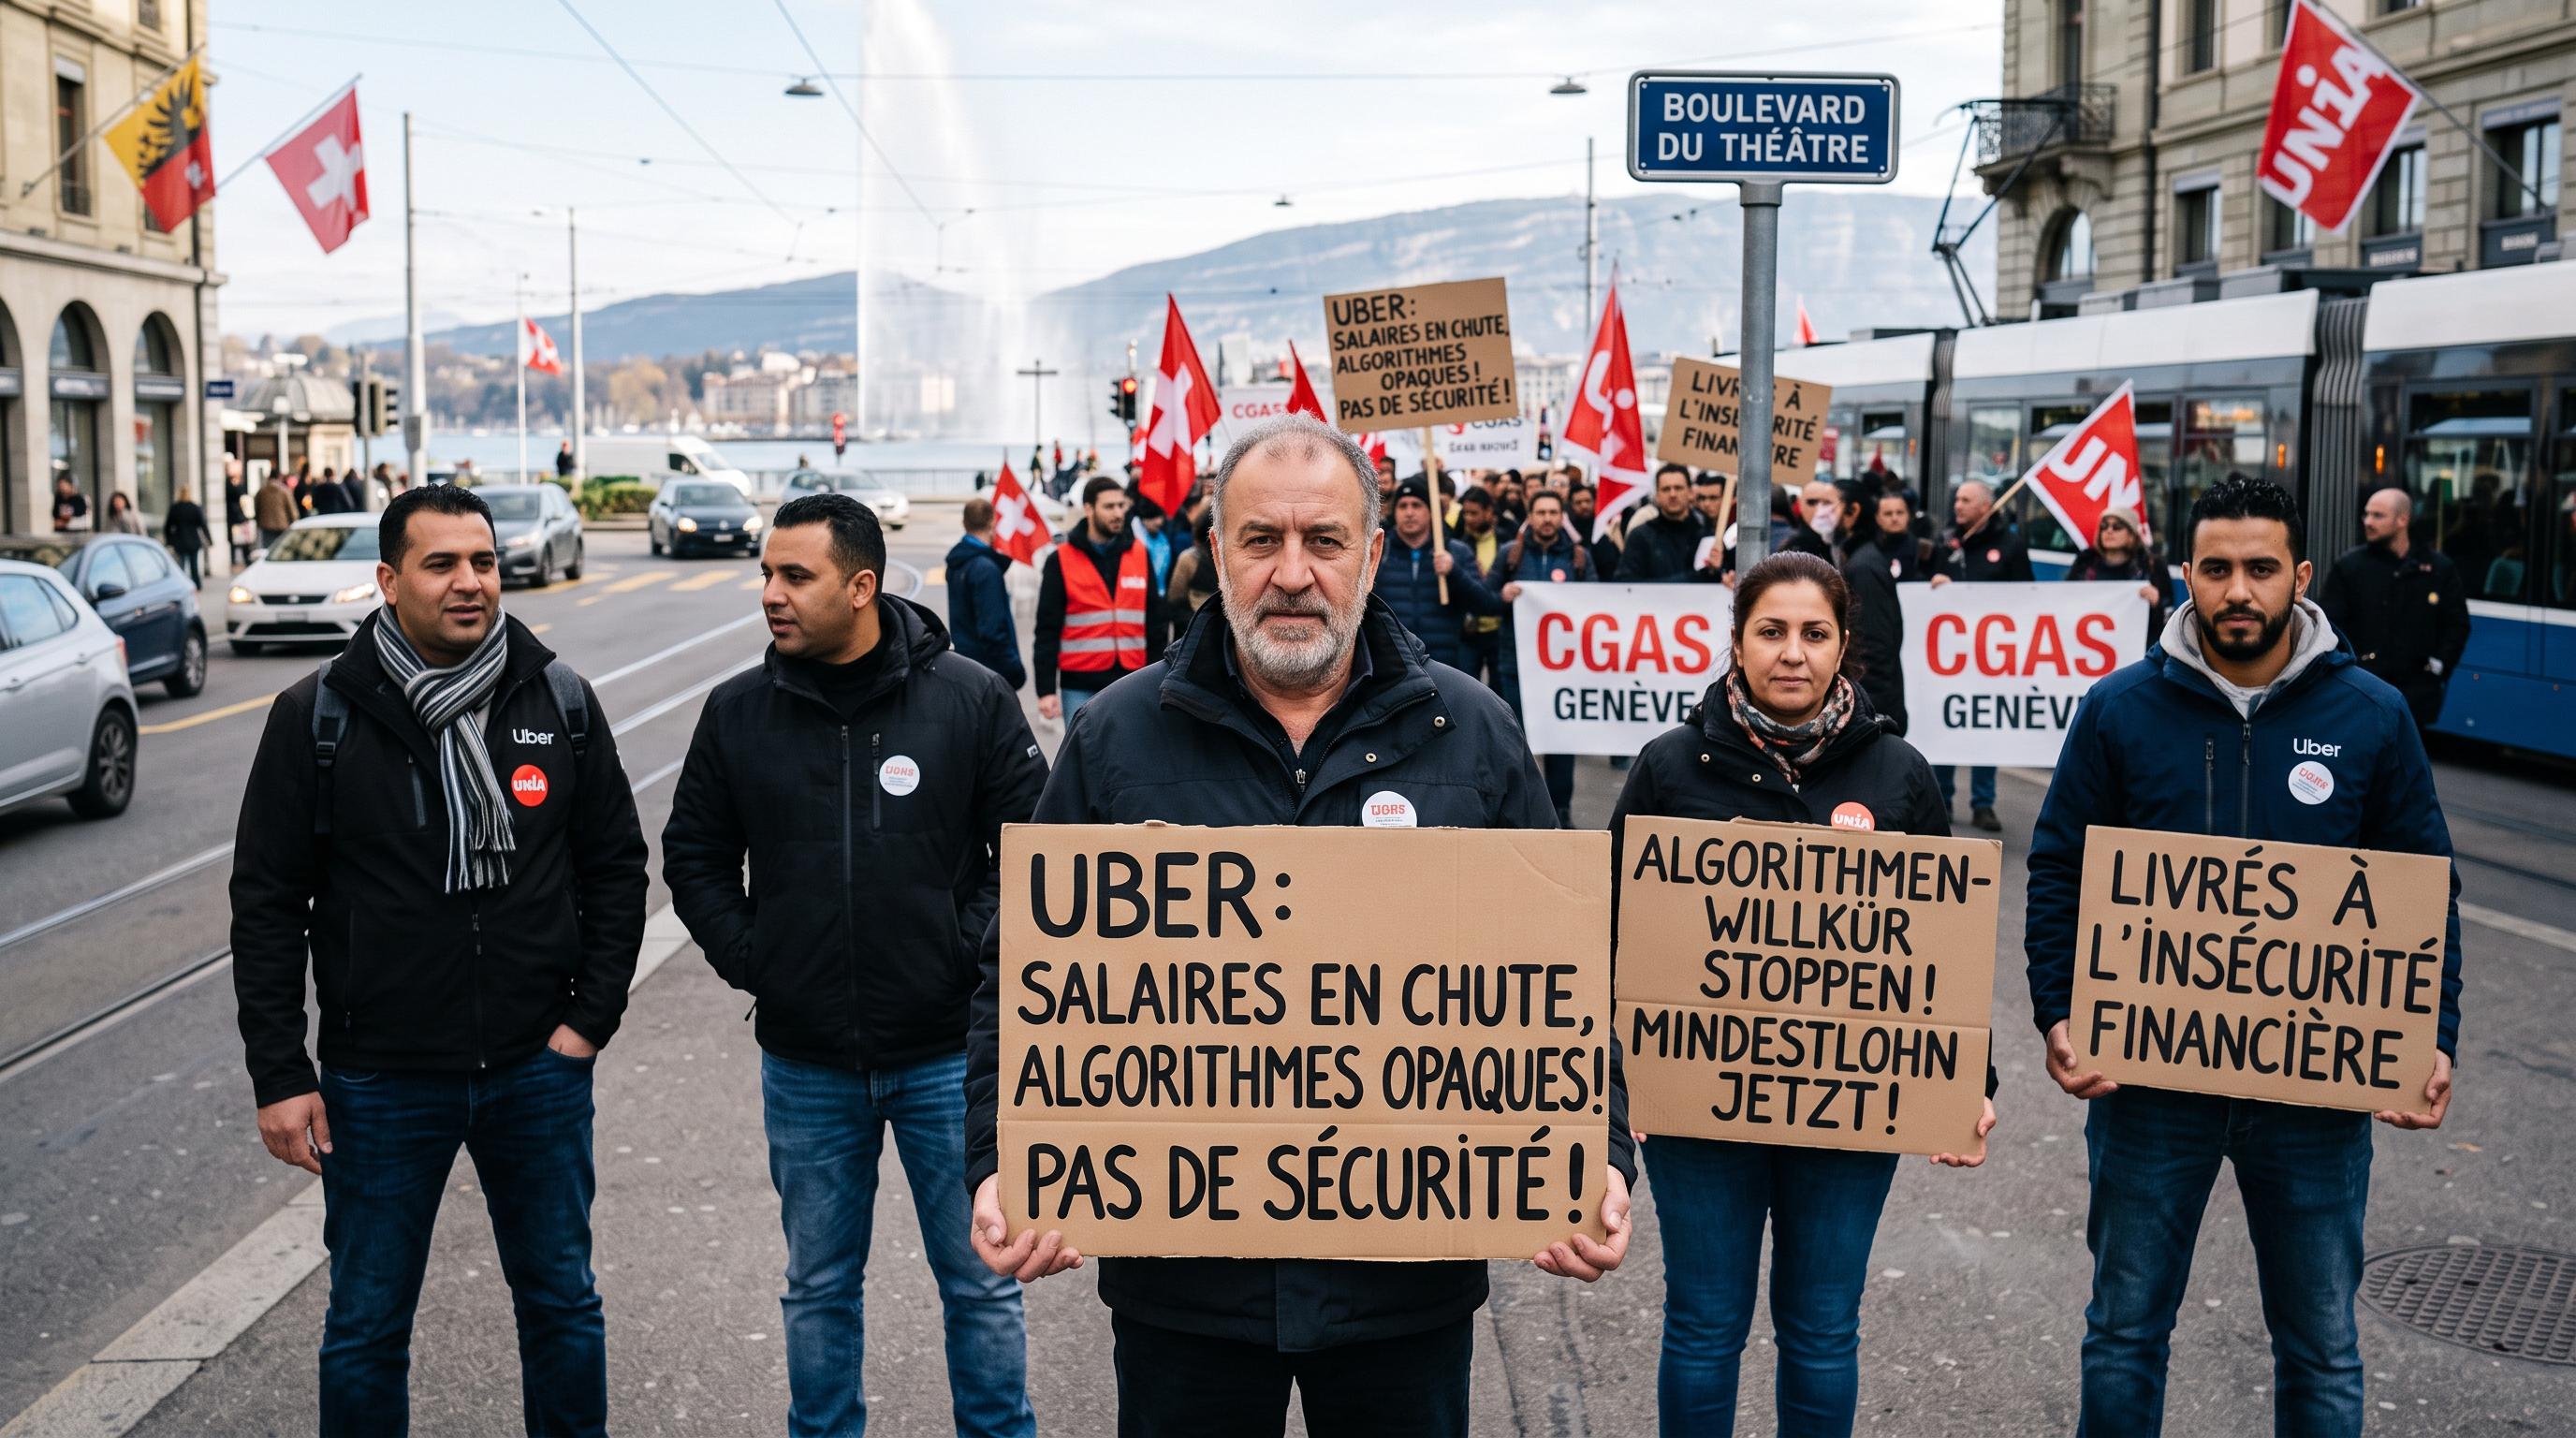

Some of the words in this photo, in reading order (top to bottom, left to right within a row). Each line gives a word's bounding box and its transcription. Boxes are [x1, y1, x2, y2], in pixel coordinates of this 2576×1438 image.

[1663, 93, 1866, 124] BOULEVARD
[1658, 132, 1703, 161] DU
[1720, 126, 1869, 163] THÉÂTRE
[1334, 323, 1420, 351] SALAIRES
[1425, 320, 1447, 342] EN
[1451, 314, 1510, 339] CHUTE,
[1337, 342, 1467, 374] ALGORITHMES
[1339, 397, 1374, 420] PAS
[1380, 394, 1403, 417] DE
[1785, 383, 1801, 411] À
[1537, 612, 1711, 674] CGAS
[1925, 613, 2117, 677] CGAS
[1942, 686, 2085, 730] GENÈV
[513, 728, 554, 745] Uber
[2293, 738, 2341, 757] Uber
[2111, 844, 2299, 920] LIVRÉS
[2332, 854, 2378, 930] À
[1705, 895, 1912, 957] WILLKÜR
[1017, 961, 1287, 1025] SALAIRES
[1310, 962, 1381, 1027] EN
[1402, 963, 1594, 1036] CHUTE,
[1632, 1007, 1958, 1081] MINDESTLOHN
[1014, 1045, 1364, 1109] ALGORITHMES
[1383, 1046, 1604, 1116] OPAQUES!
[1028, 1143, 1142, 1221] PAS
[1168, 1145, 1239, 1221] DE
